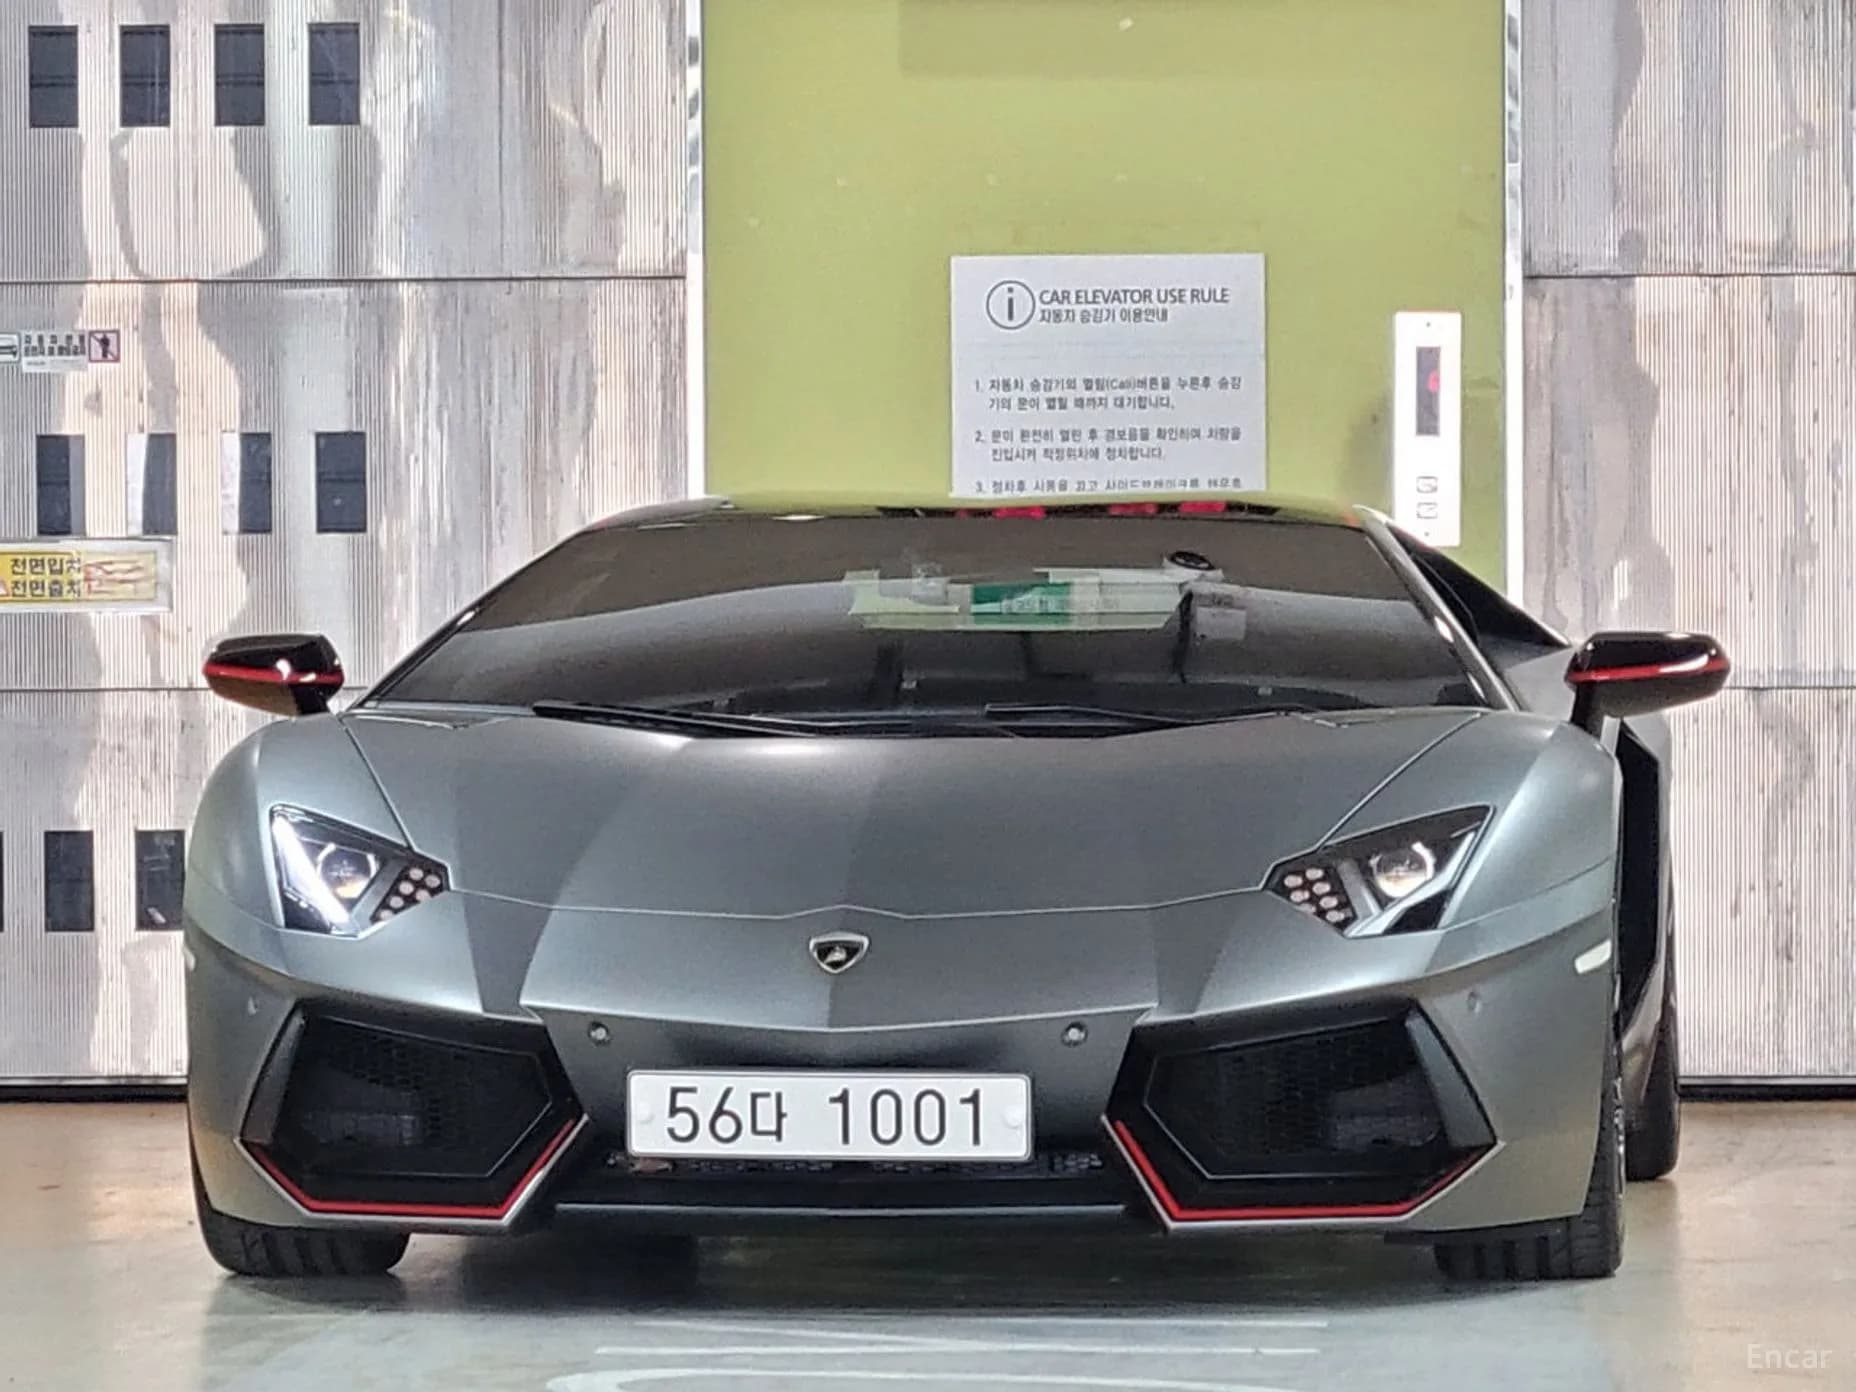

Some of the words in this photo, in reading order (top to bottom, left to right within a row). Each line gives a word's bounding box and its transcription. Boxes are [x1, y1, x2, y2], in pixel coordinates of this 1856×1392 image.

[1039, 289, 1071, 305] CAR
[1075, 288, 1154, 305] ELEVATOR
[1157, 288, 1187, 304] USE
[1190, 287, 1230, 303] RULE
[1039, 309, 1076, 324] 자동차
[1080, 309, 1116, 324] 승강기
[1120, 309, 1168, 323] 이용안내
[989, 377, 1024, 393] 자동차
[989, 396, 1012, 411] 기의
[1017, 396, 1040, 411] 문이
[991, 429, 1014, 443] 문이
[1020, 429, 1054, 443] 완전히
[1156, 427, 1201, 441] 확인하여
[666, 1086, 788, 1144] 56다
[828, 1088, 982, 1146] 1001
